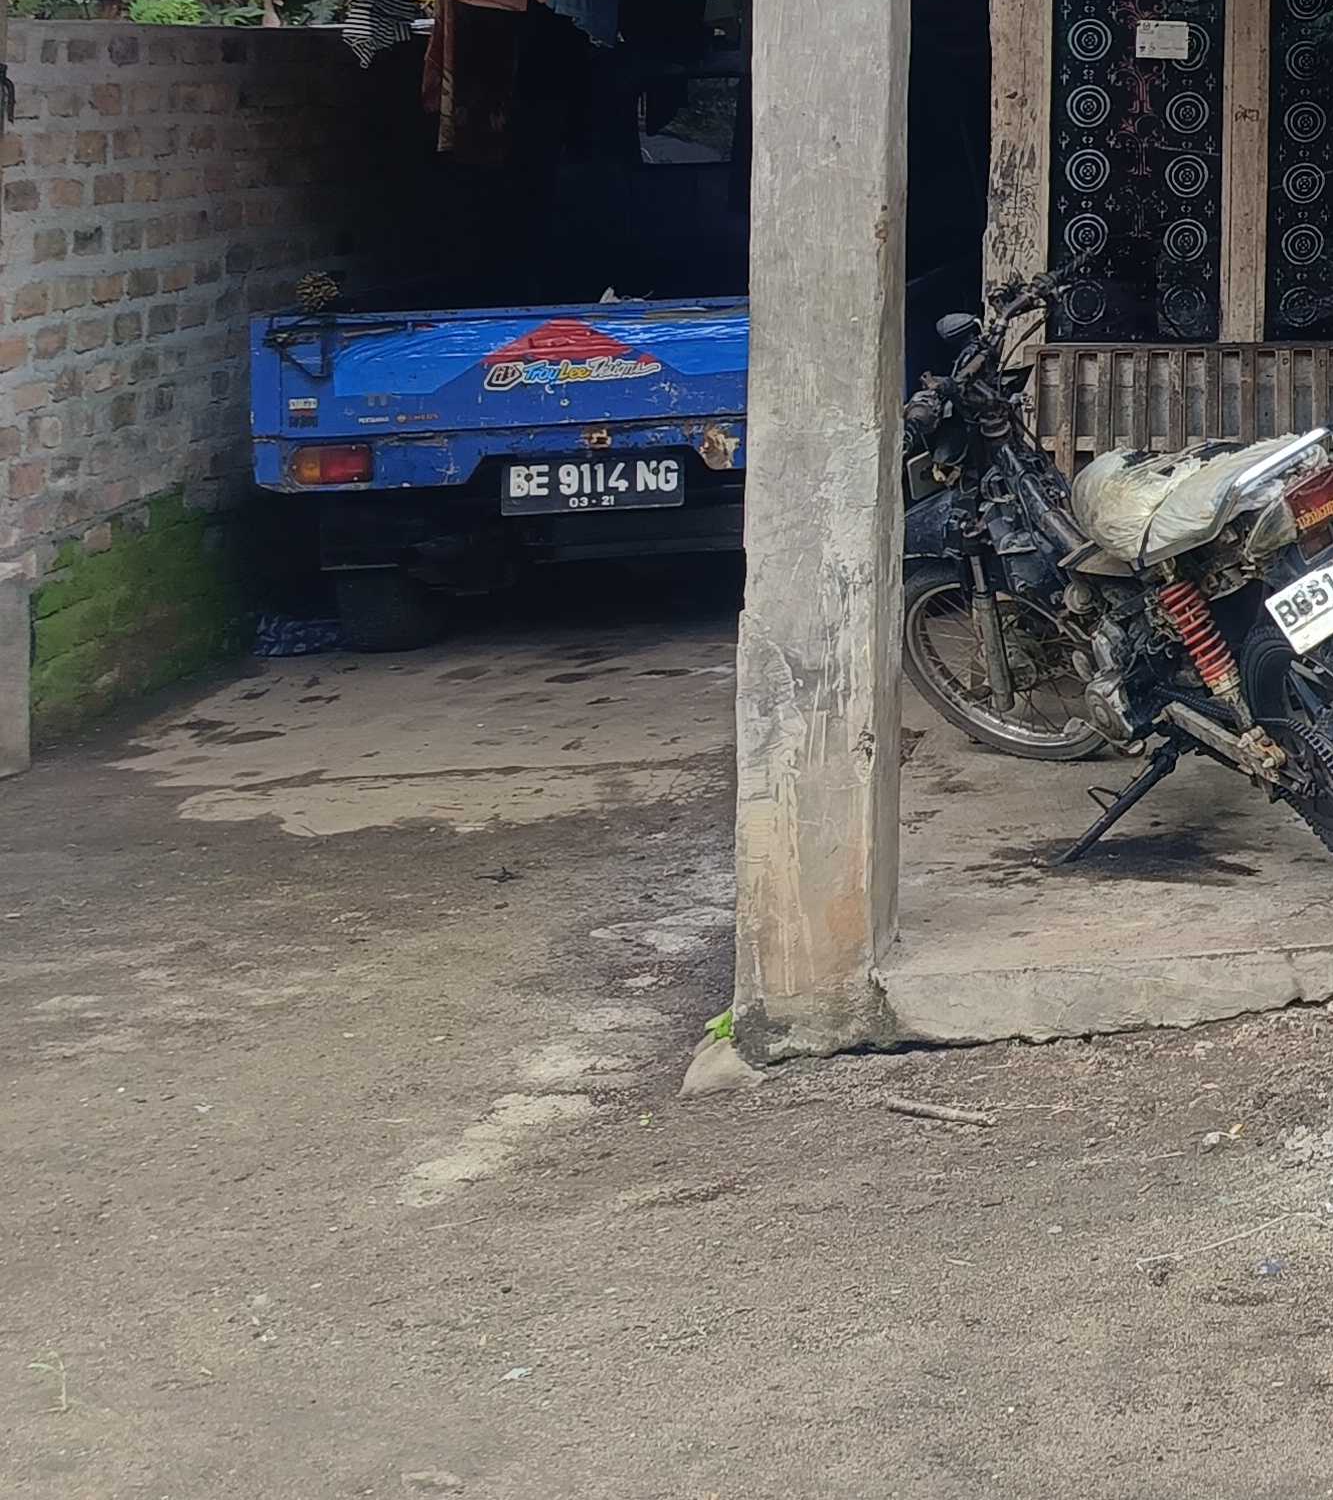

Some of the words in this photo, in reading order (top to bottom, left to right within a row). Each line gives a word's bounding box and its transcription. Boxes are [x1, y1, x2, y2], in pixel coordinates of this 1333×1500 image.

[509, 464, 549, 498] BE
[558, 462, 629, 495] 9114
[636, 460, 679, 492] NG
[569, 497, 588, 508] 03
[601, 495, 615, 506] 21
